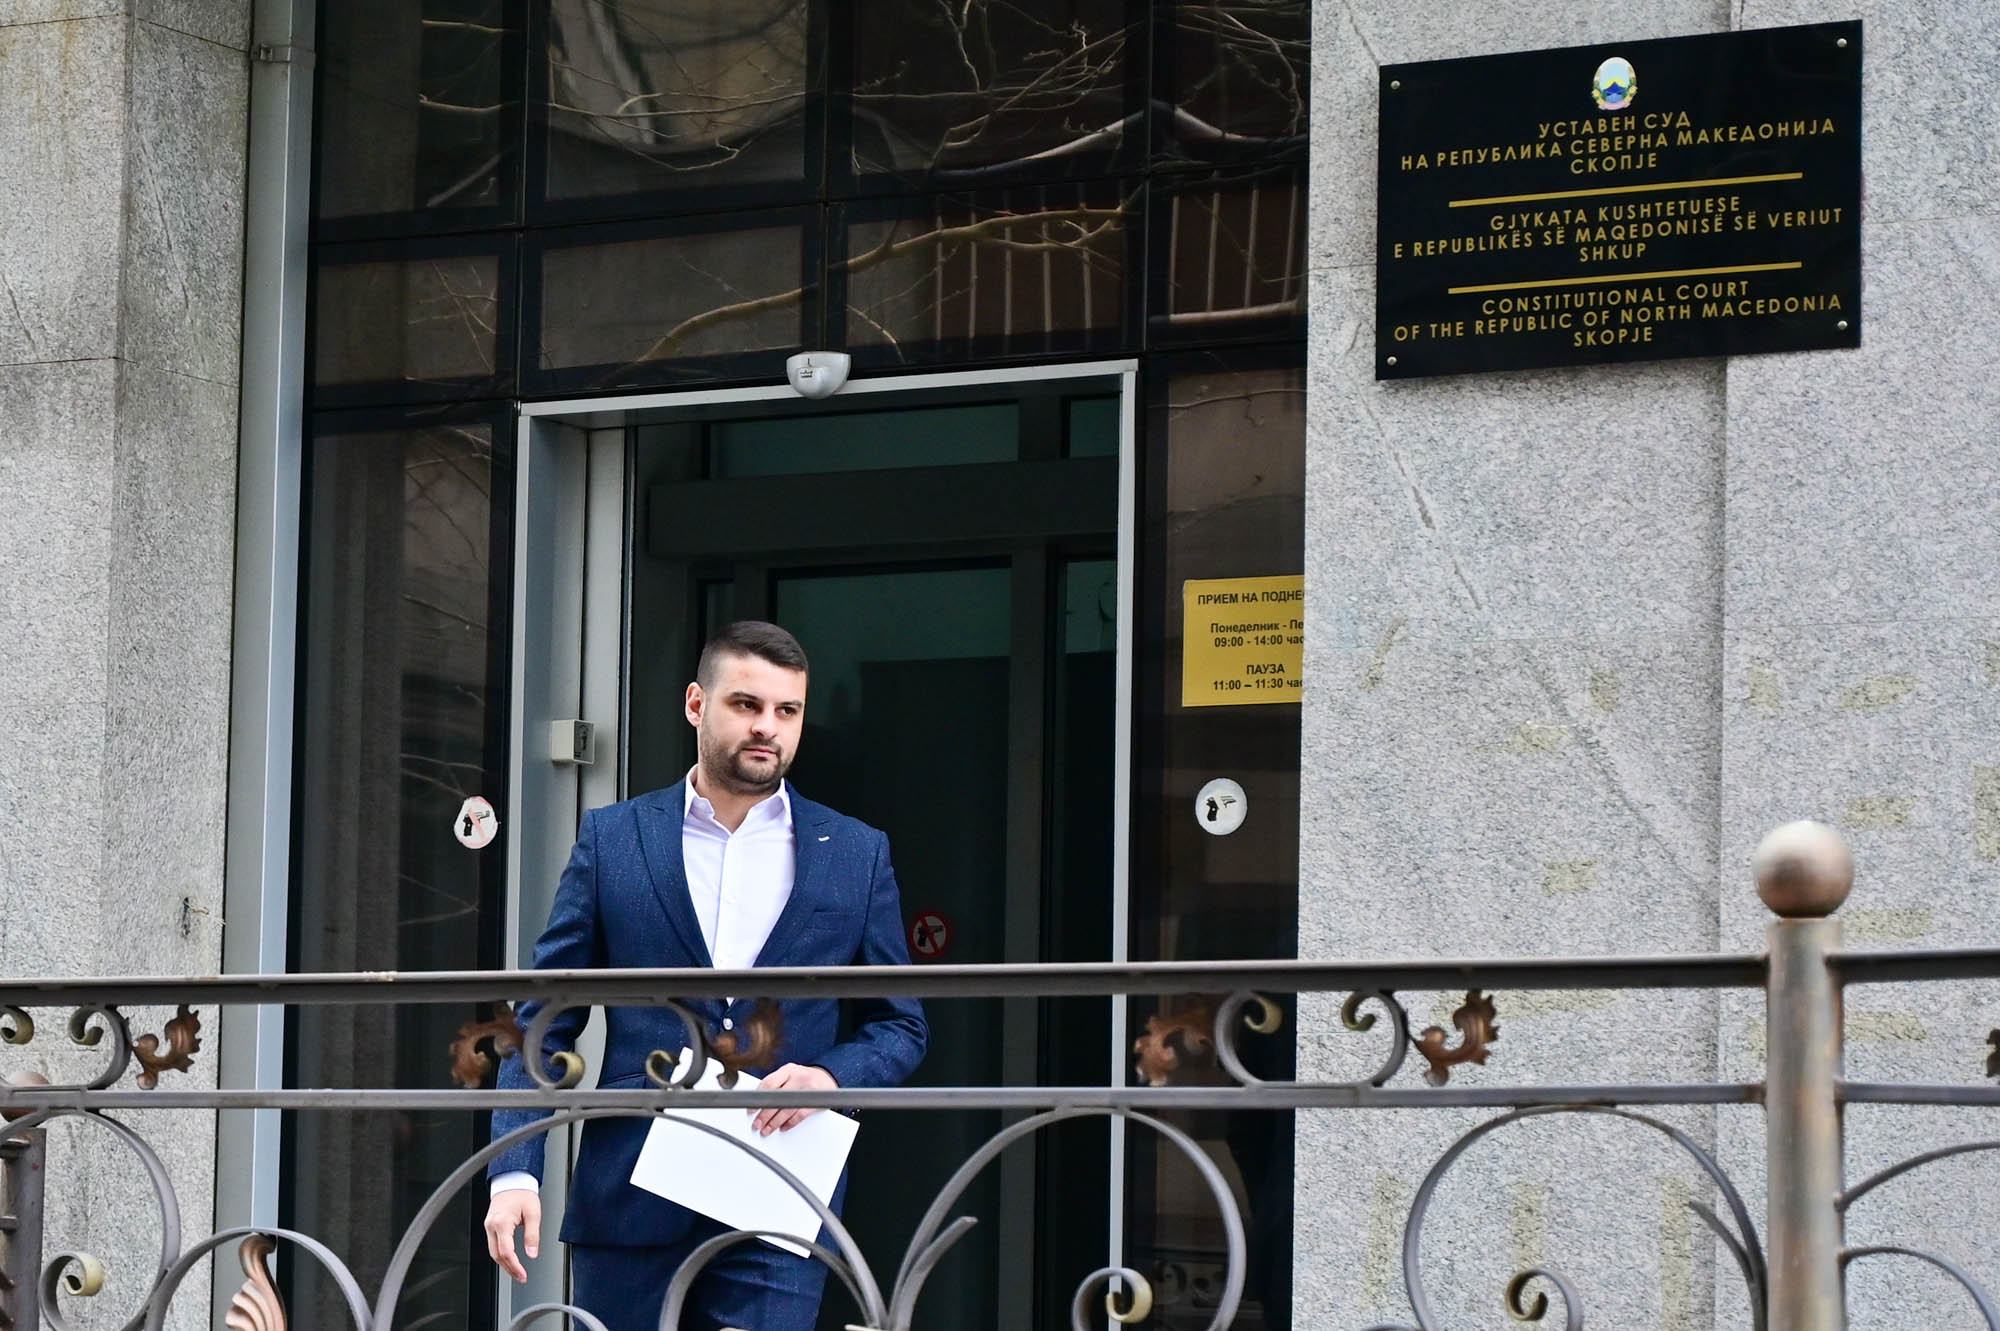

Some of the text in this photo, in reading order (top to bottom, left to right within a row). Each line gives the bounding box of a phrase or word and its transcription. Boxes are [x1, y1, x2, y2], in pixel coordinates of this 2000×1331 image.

[1538, 111, 1691, 139] УСТАВЕН СУД
[1401, 118, 1835, 171] НА РЕПУБЛИКА СЕВЕРНА МАКЕДОНИЈА
[1570, 152, 1657, 174] СКОПЈЕ
[1490, 196, 1740, 231] GJYKATA KUSHTETUESE
[1394, 207, 1843, 259] E REPUBLIKËS SË MAQEDONISË SË VERIUT
[1579, 242, 1647, 262] SHKUP
[1482, 280, 1749, 316] CONSTITUTIONAL COURT
[1394, 294, 1842, 342] OF THE REPUBLIC OF NORTH MACEDONIA
[1574, 326, 1653, 347] SKOPJE
[1198, 590, 1304, 605] ПРИЕМ НА ПОДНЕ
[1210, 622, 1280, 633] Понеделник
[1214, 636, 1244, 647] 09:00
[1254, 635, 1283, 646] 14:00
[1246, 663, 1286, 675] ПАУЗА
[1213, 680, 1241, 690] 11:00
[1255, 678, 1283, 689] 11:30
